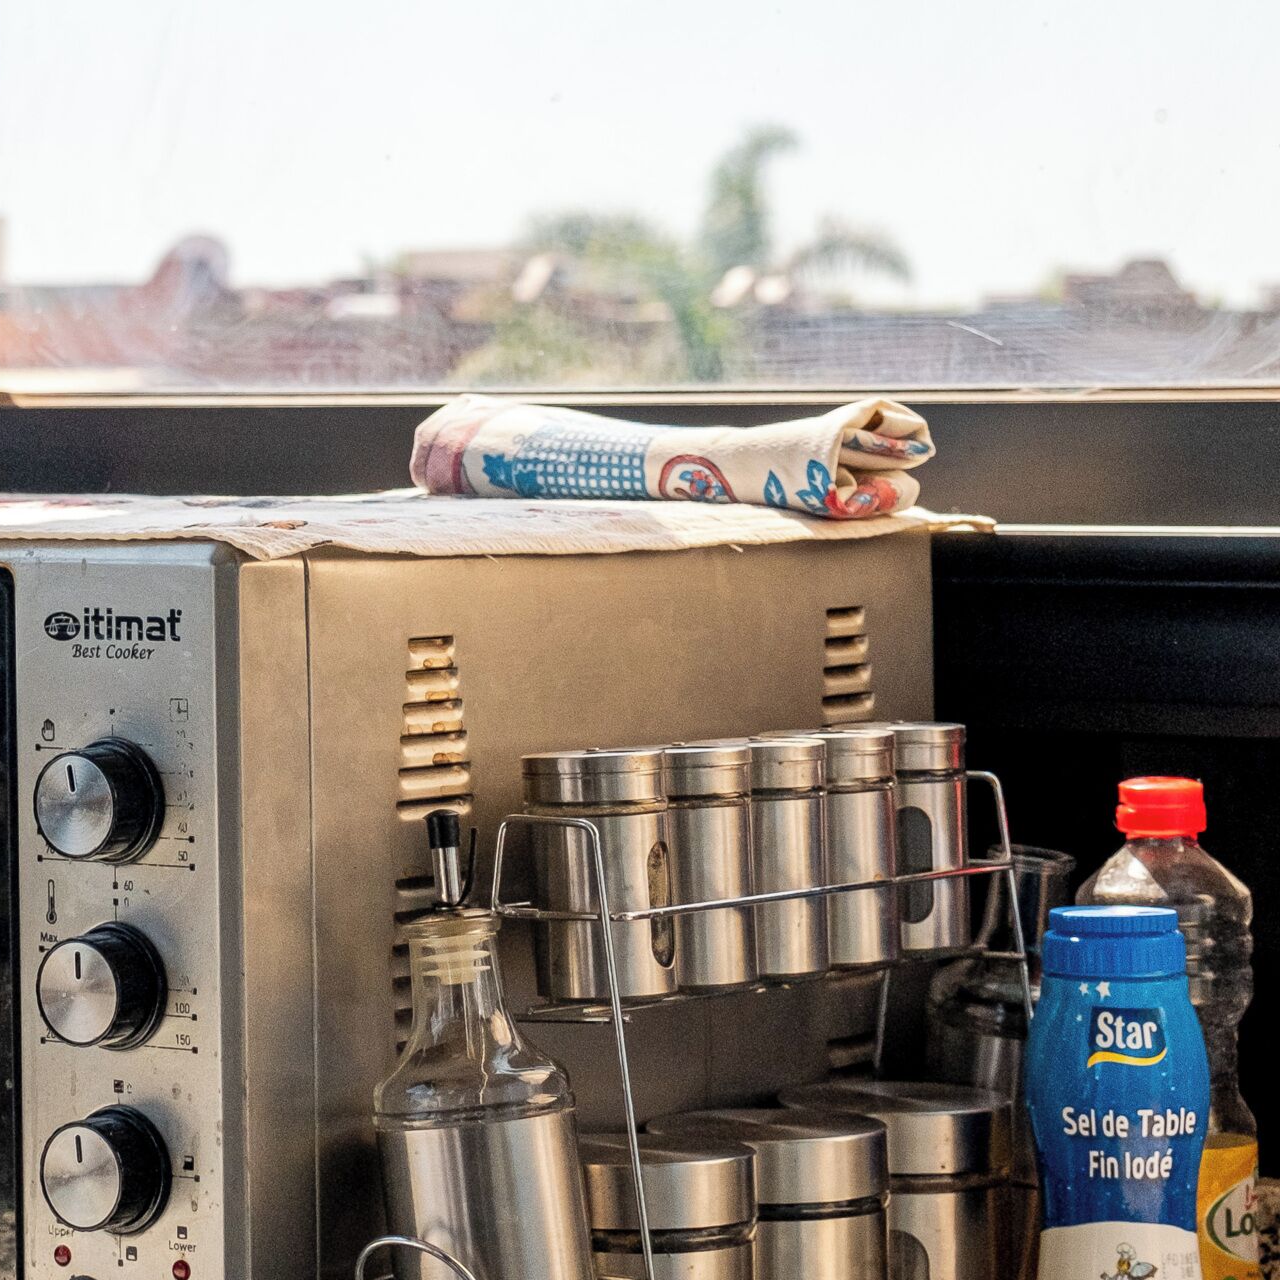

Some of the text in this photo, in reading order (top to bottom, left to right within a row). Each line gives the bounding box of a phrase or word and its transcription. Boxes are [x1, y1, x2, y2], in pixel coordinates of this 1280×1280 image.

[83, 607, 183, 642] itimat
[72, 642, 155, 660] Best Cooker
[177, 850, 188, 861] 50
[123, 880, 134, 891] 60
[40, 931, 58, 942] Max
[175, 1002, 190, 1014] 100
[1095, 1011, 1157, 1050] Star
[175, 1033, 191, 1046] 150
[1062, 1106, 1196, 1138] Sel de Table
[1089, 1148, 1173, 1180] Fin Iodé
[1225, 1208, 1258, 1238] Lo
[168, 1240, 197, 1253] Lower
